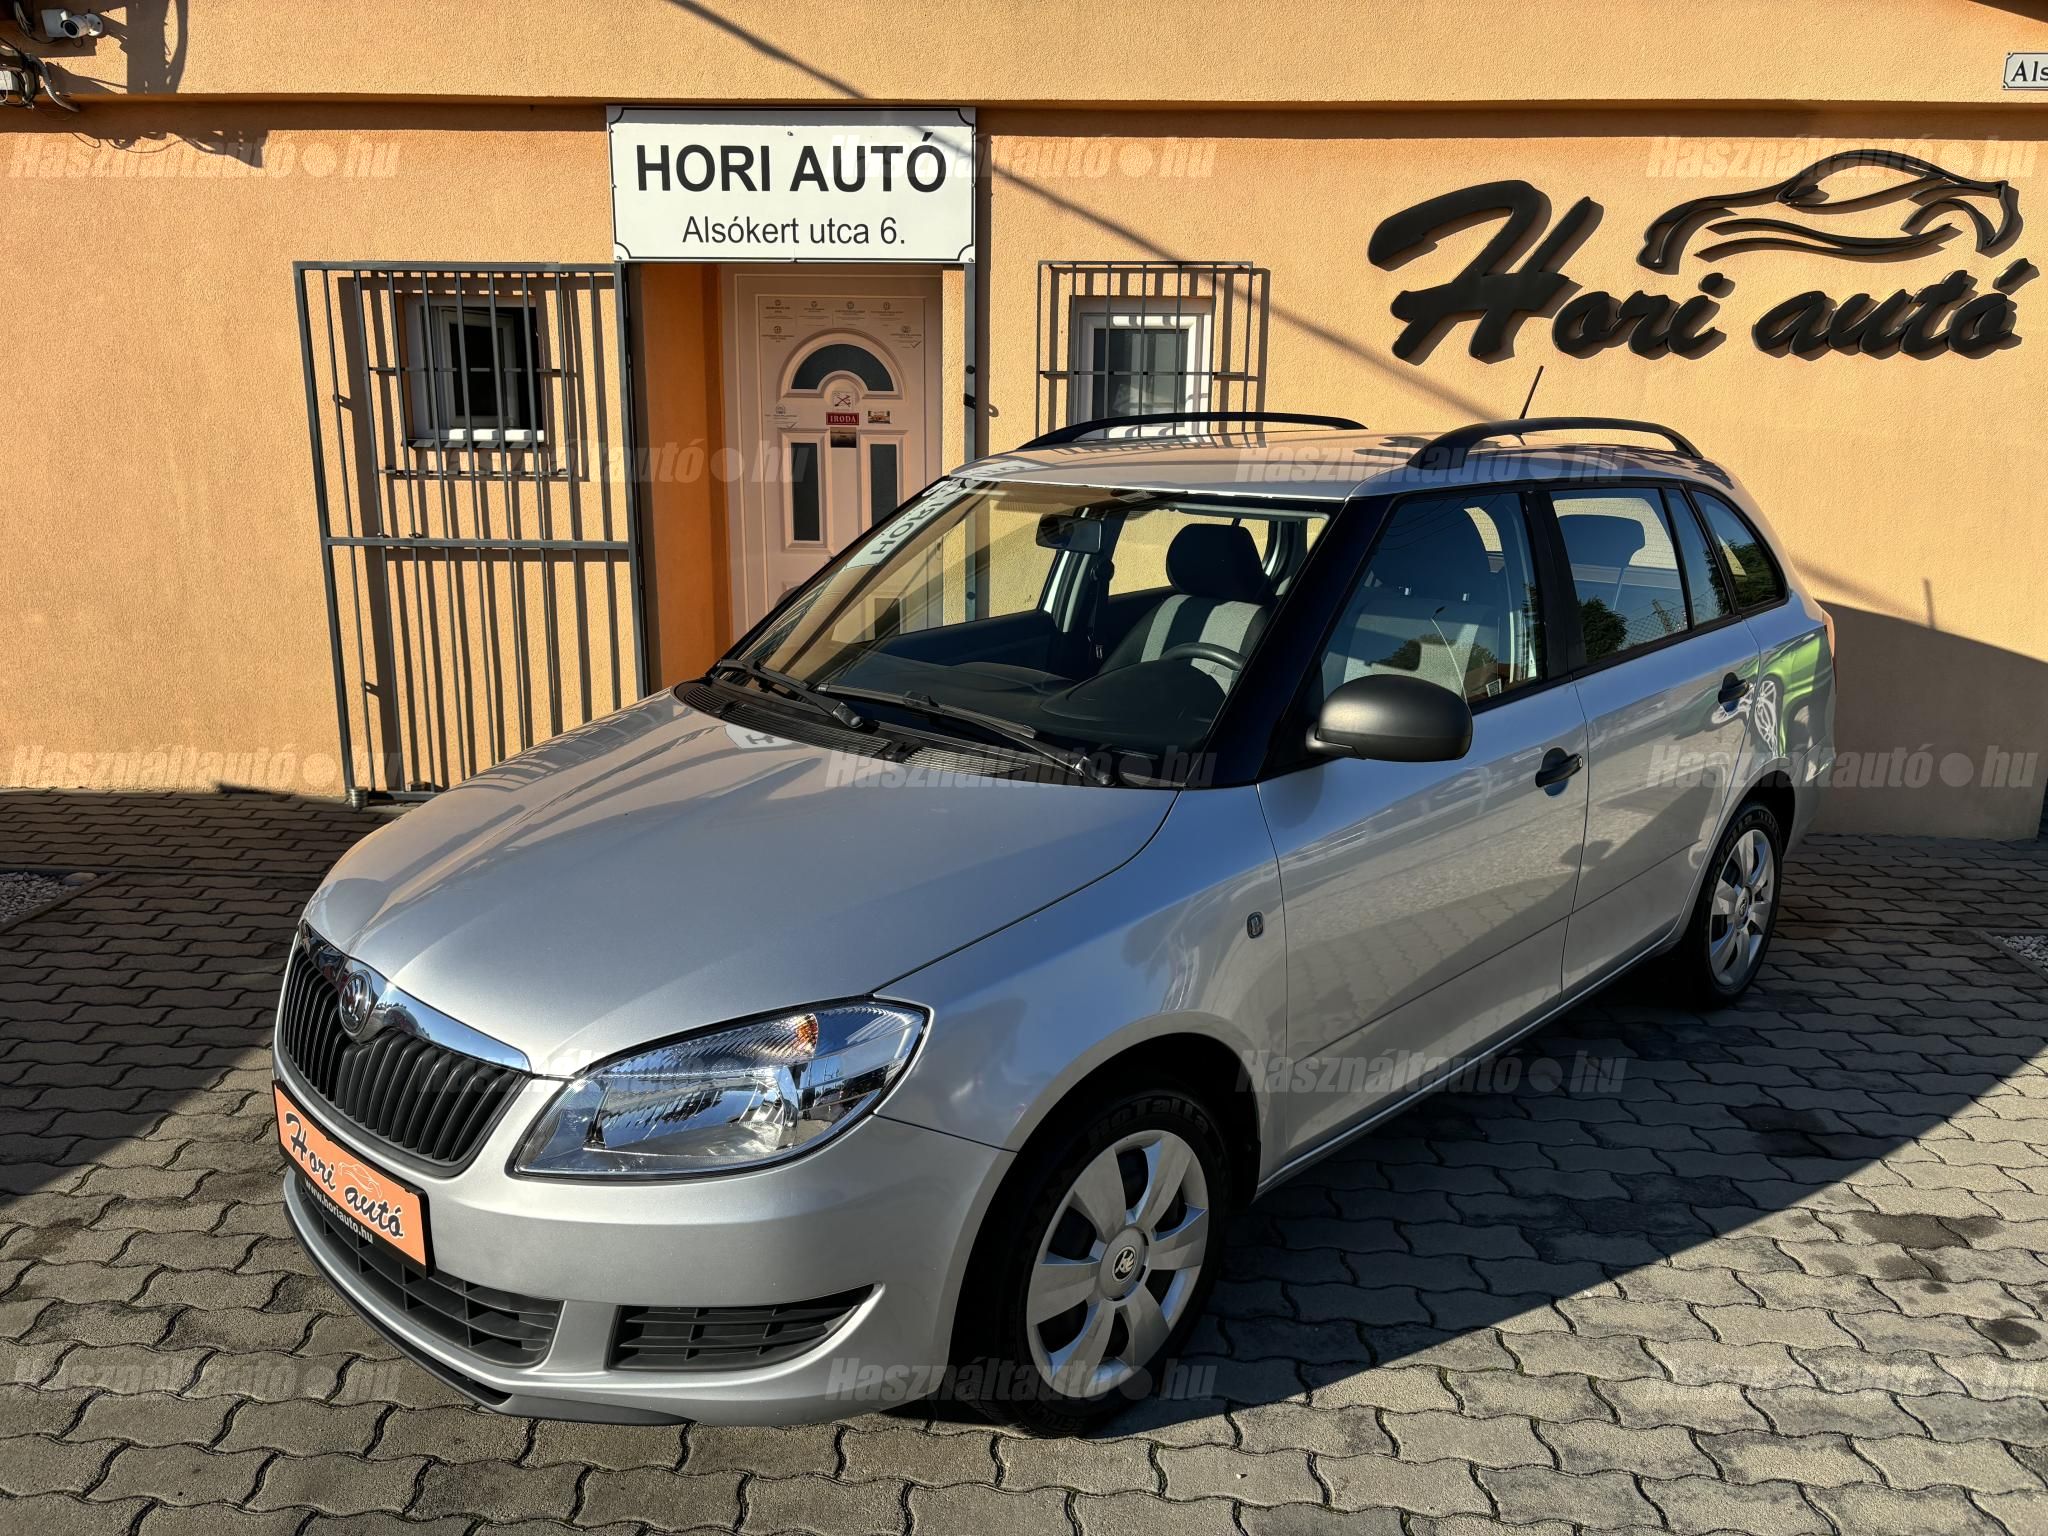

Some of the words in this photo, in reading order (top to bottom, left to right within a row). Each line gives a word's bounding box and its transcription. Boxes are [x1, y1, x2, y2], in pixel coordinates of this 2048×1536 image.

[636, 144, 770, 192] HORI
[789, 132, 947, 193] AUTÓ
[682, 216, 799, 244] Alsókert
[809, 218, 870, 244] utca
[880, 217, 905, 244] 6.
[1368, 179, 1721, 360] Hori
[1752, 258, 2030, 360] autó
[829, 414, 857, 424] IRODA
[286, 1112, 336, 1191] Hori
[344, 1187, 404, 1238] autó
